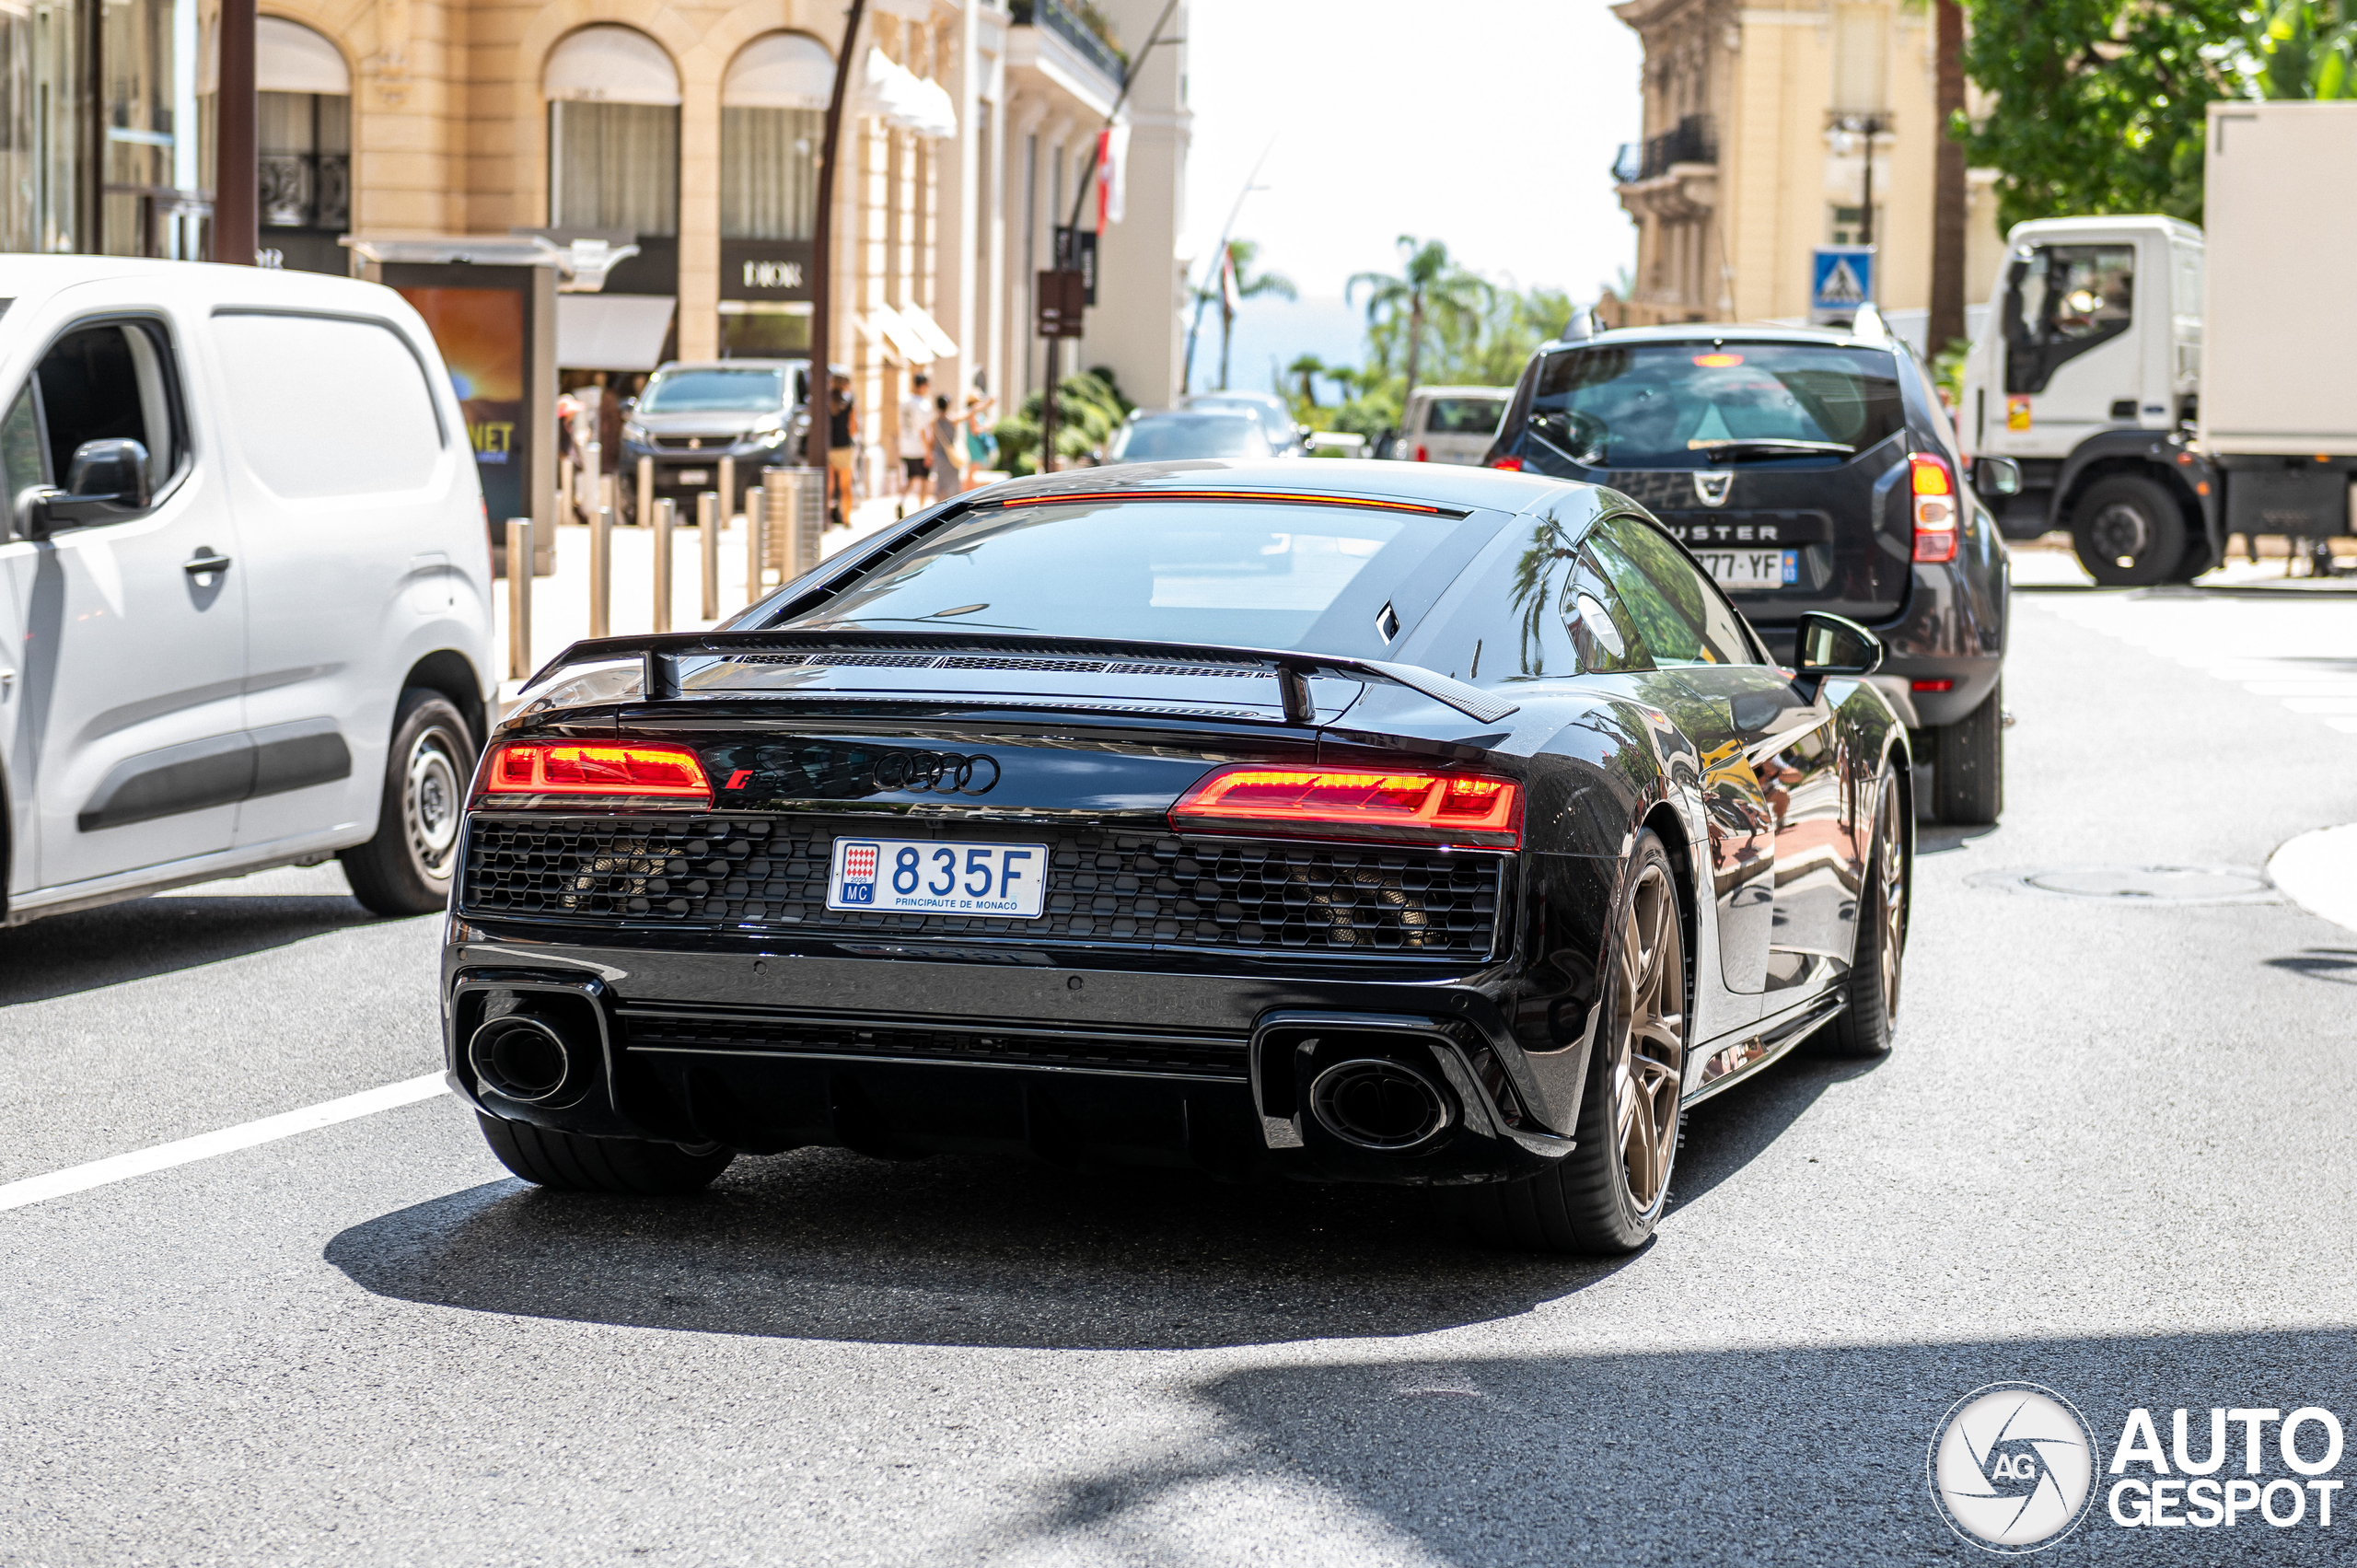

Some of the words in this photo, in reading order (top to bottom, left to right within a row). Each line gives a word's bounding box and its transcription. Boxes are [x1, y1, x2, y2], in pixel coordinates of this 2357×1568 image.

[742, 260, 803, 288] DIOR
[892, 846, 1032, 899] 835F
[846, 885, 868, 901] MC
[895, 898, 957, 908] PRINCIPAUTE
[959, 900, 973, 909] DE
[976, 900, 1018, 911] MONACO
